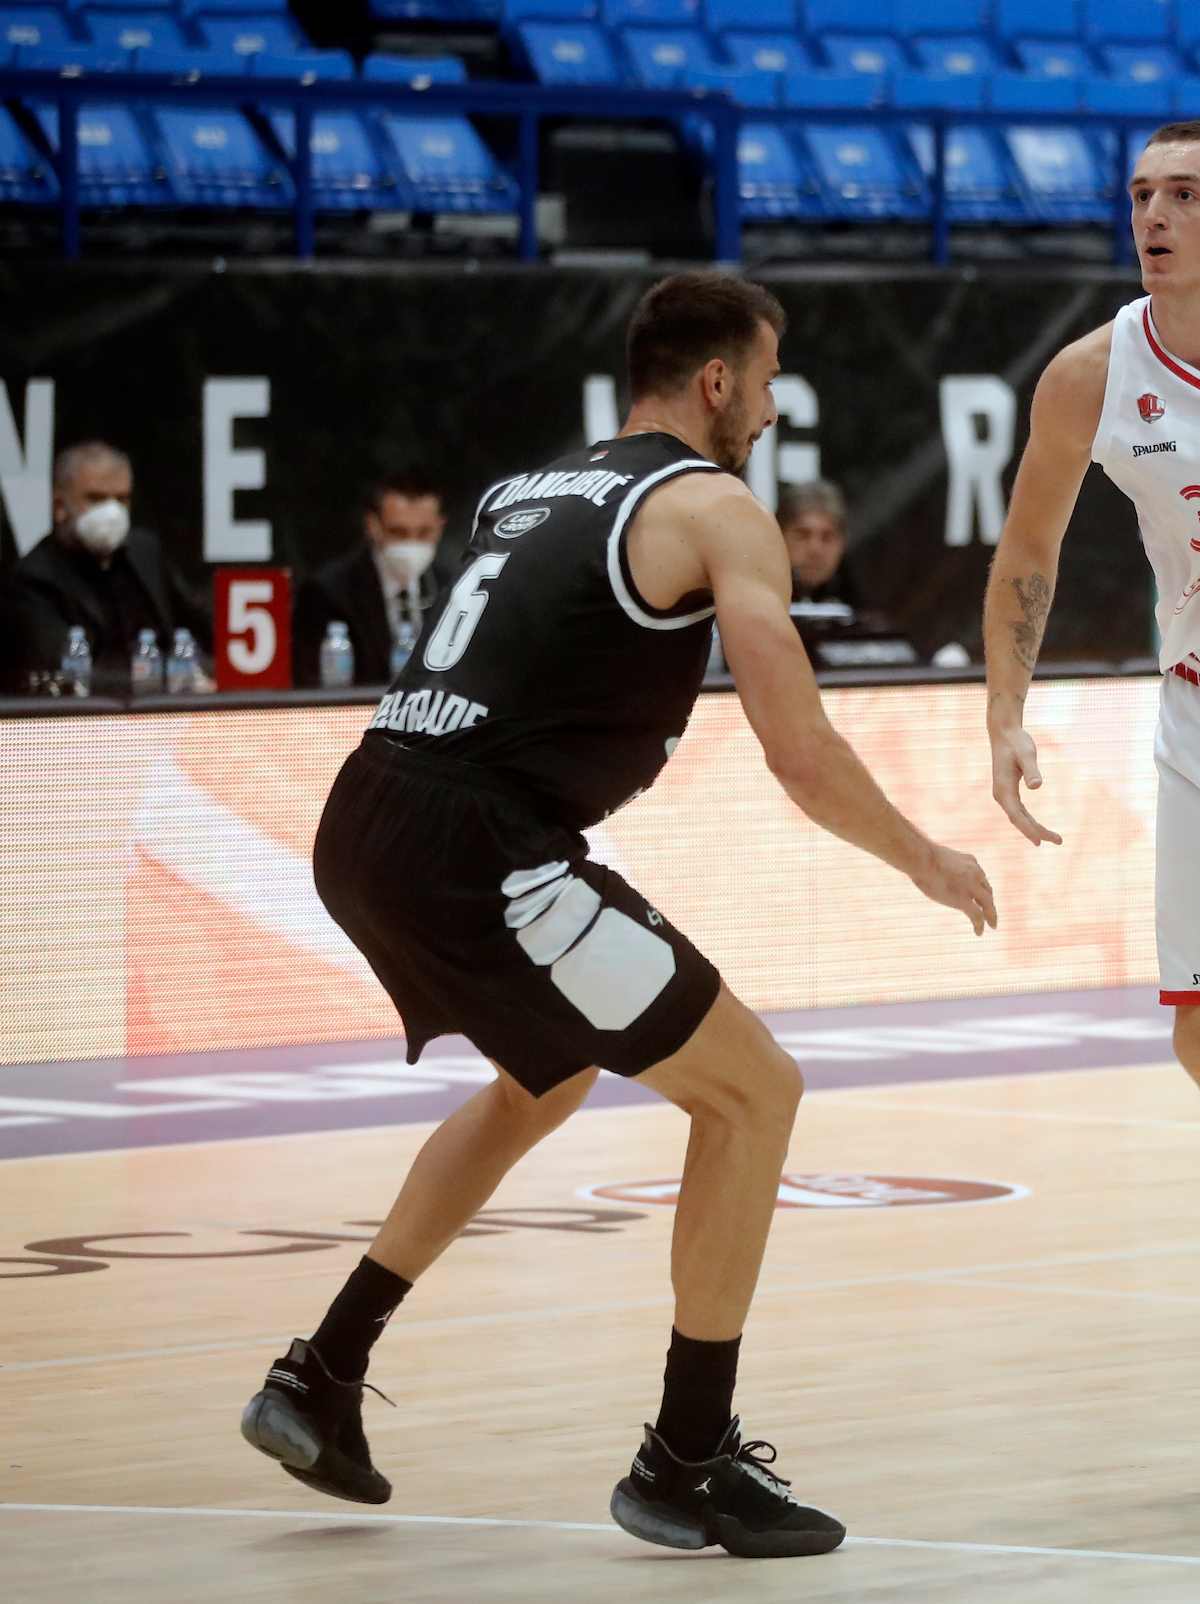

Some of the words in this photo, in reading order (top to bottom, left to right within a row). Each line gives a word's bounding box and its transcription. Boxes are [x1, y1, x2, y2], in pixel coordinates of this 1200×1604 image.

[1132, 441, 1177, 457] SPALDING
[226, 580, 277, 673] 5
[423, 553, 511, 671] 6
